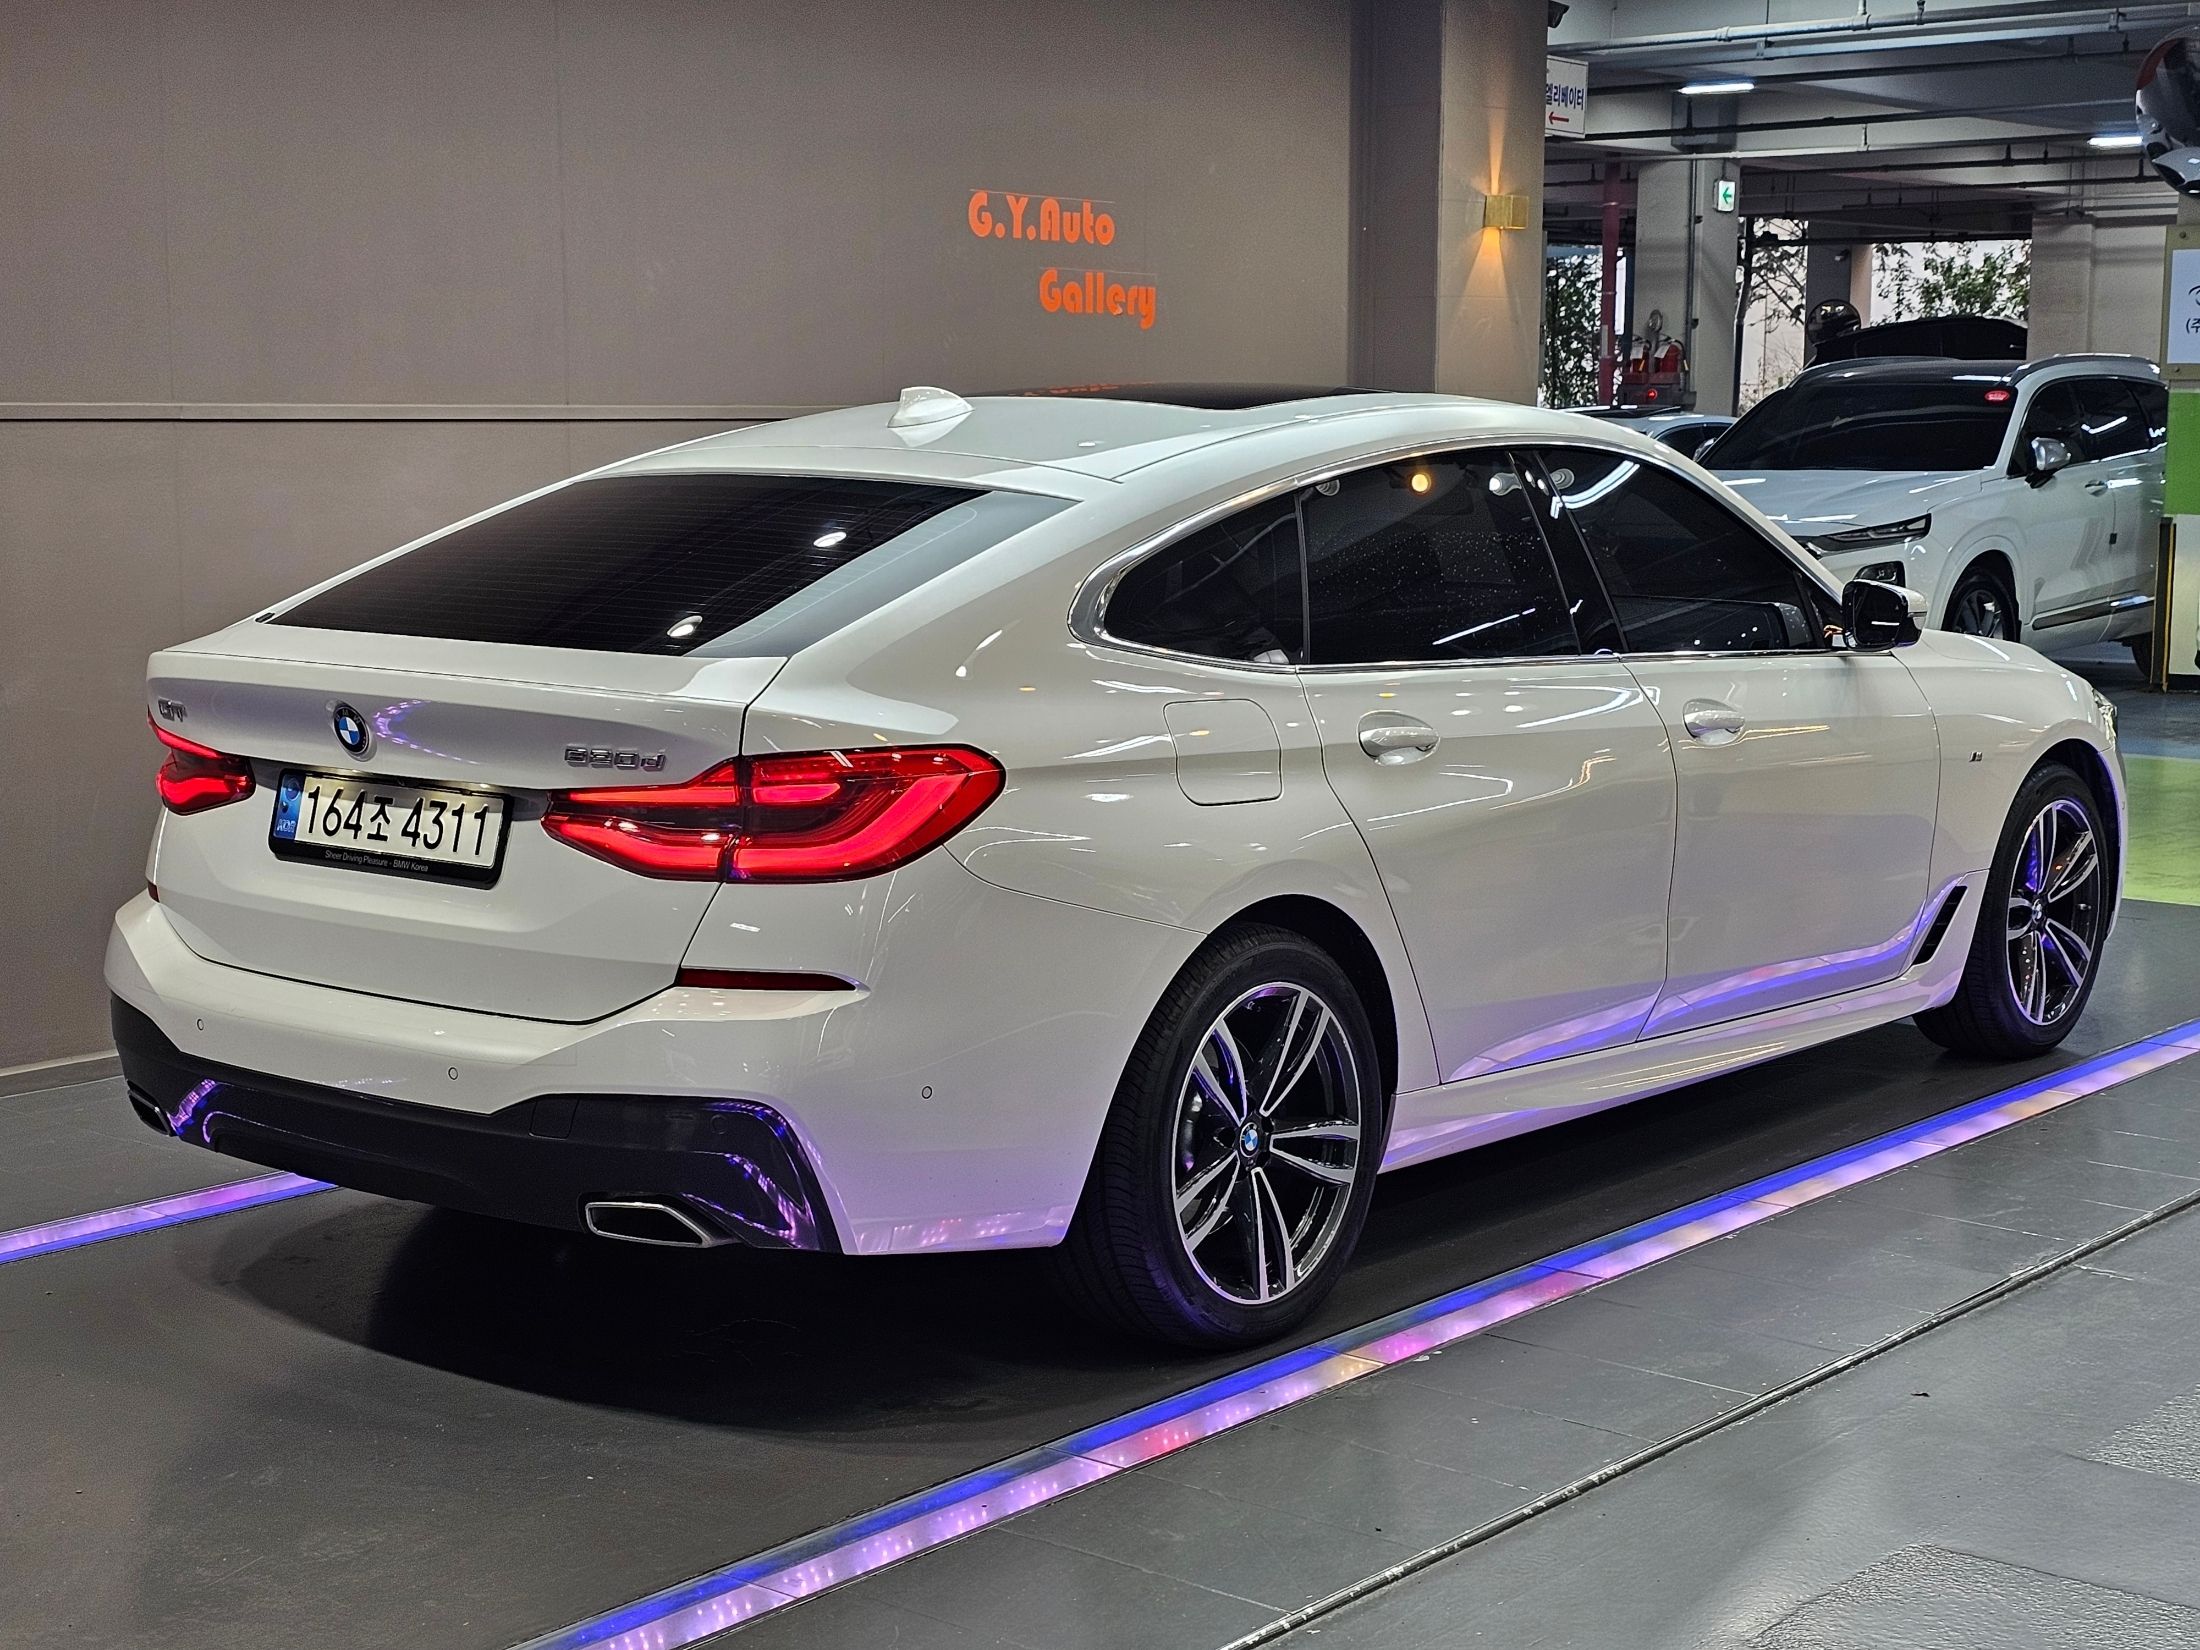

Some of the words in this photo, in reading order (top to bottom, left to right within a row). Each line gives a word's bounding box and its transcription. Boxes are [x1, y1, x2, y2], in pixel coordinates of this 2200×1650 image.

[968, 190, 1115, 246] G.Y.Auto
[1039, 267, 1156, 330] Gallery
[307, 785, 395, 842] 164조
[401, 797, 489, 856] 4311
[325, 850, 342, 860] Sheer
[342, 852, 363, 864] Driving
[363, 855, 388, 867] Pleasure
[393, 859, 410, 869] BMW
[411, 862, 429, 872] Korea
